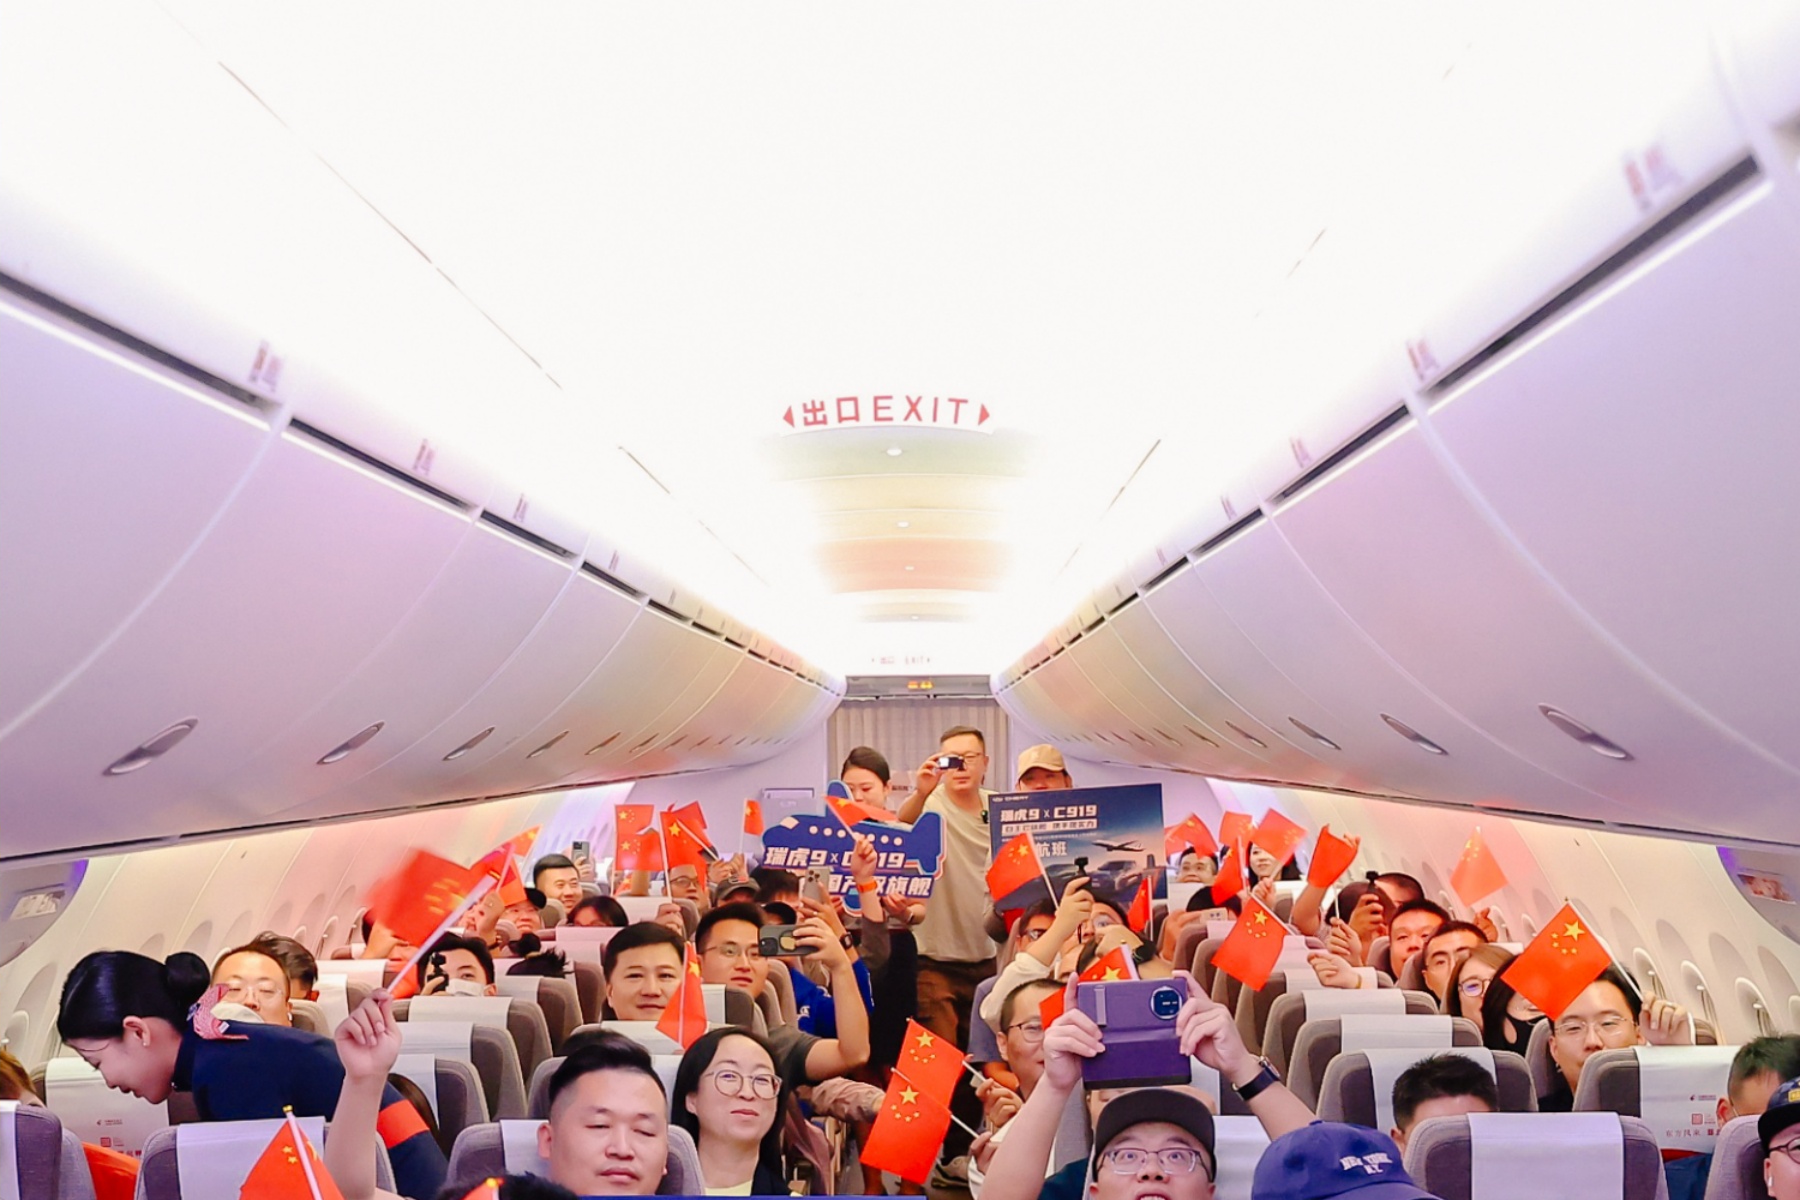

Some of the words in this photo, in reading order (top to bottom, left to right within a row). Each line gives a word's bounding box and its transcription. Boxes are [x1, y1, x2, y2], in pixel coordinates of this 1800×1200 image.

[803, 396, 860, 426] 出口
[873, 395, 969, 425] EXIT
[1053, 805, 1097, 819] C919
[764, 846, 828, 867] 瑞虎9
[841, 850, 906, 868] C19
